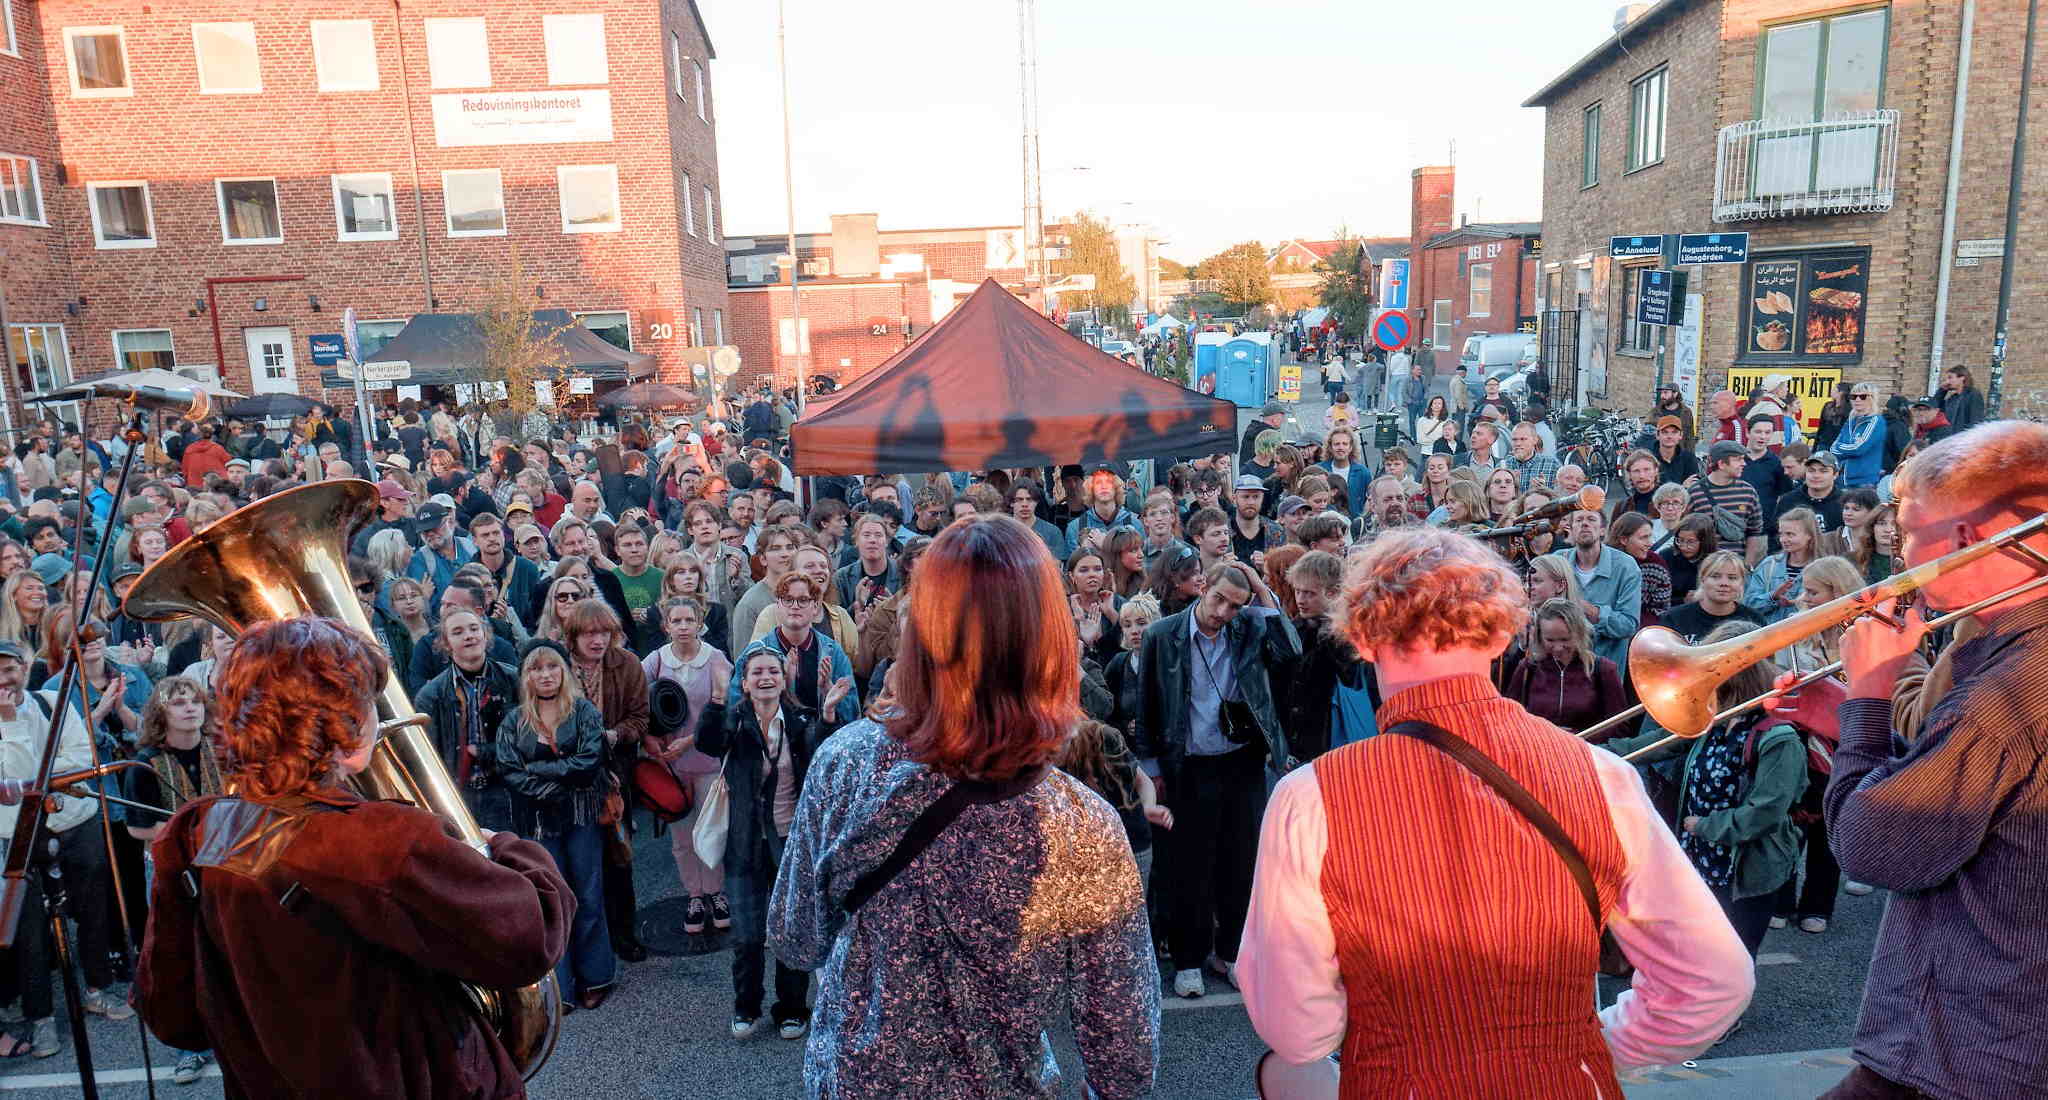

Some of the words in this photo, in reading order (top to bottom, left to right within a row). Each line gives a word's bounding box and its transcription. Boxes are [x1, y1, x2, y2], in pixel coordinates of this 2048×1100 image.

[461, 95, 582, 113] Redovisningskontoret
[1625, 245, 1659, 254] Annelund
[1681, 245, 1733, 255] Augustenborg
[650, 323, 672, 340] 20
[872, 324, 887, 335] 24
